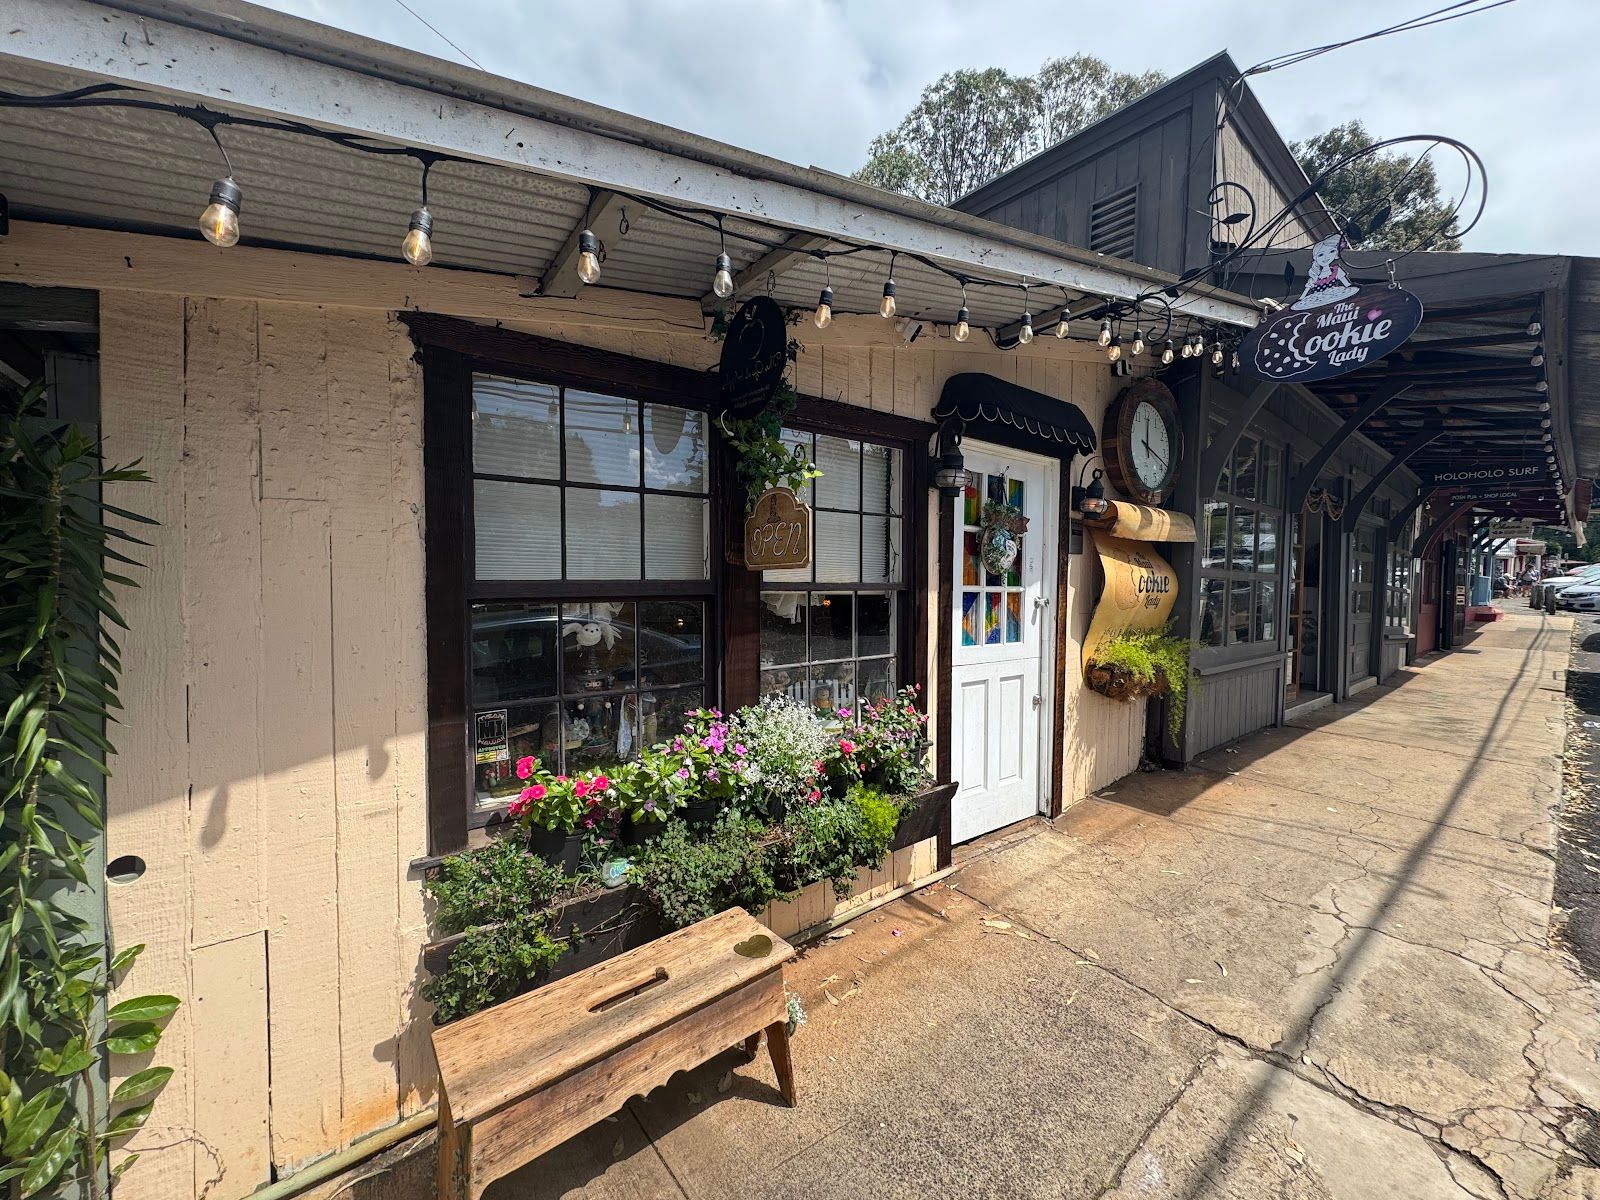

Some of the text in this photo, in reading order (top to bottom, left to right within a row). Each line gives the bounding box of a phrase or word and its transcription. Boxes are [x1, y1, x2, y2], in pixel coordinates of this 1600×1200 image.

[1316, 306, 1360, 328] Maui
[1333, 302, 1356, 314] The
[1327, 347, 1369, 367] Lady
[1434, 466, 1539, 481] HOLOHOLO SURF
[751, 522, 802, 556] OPEN
